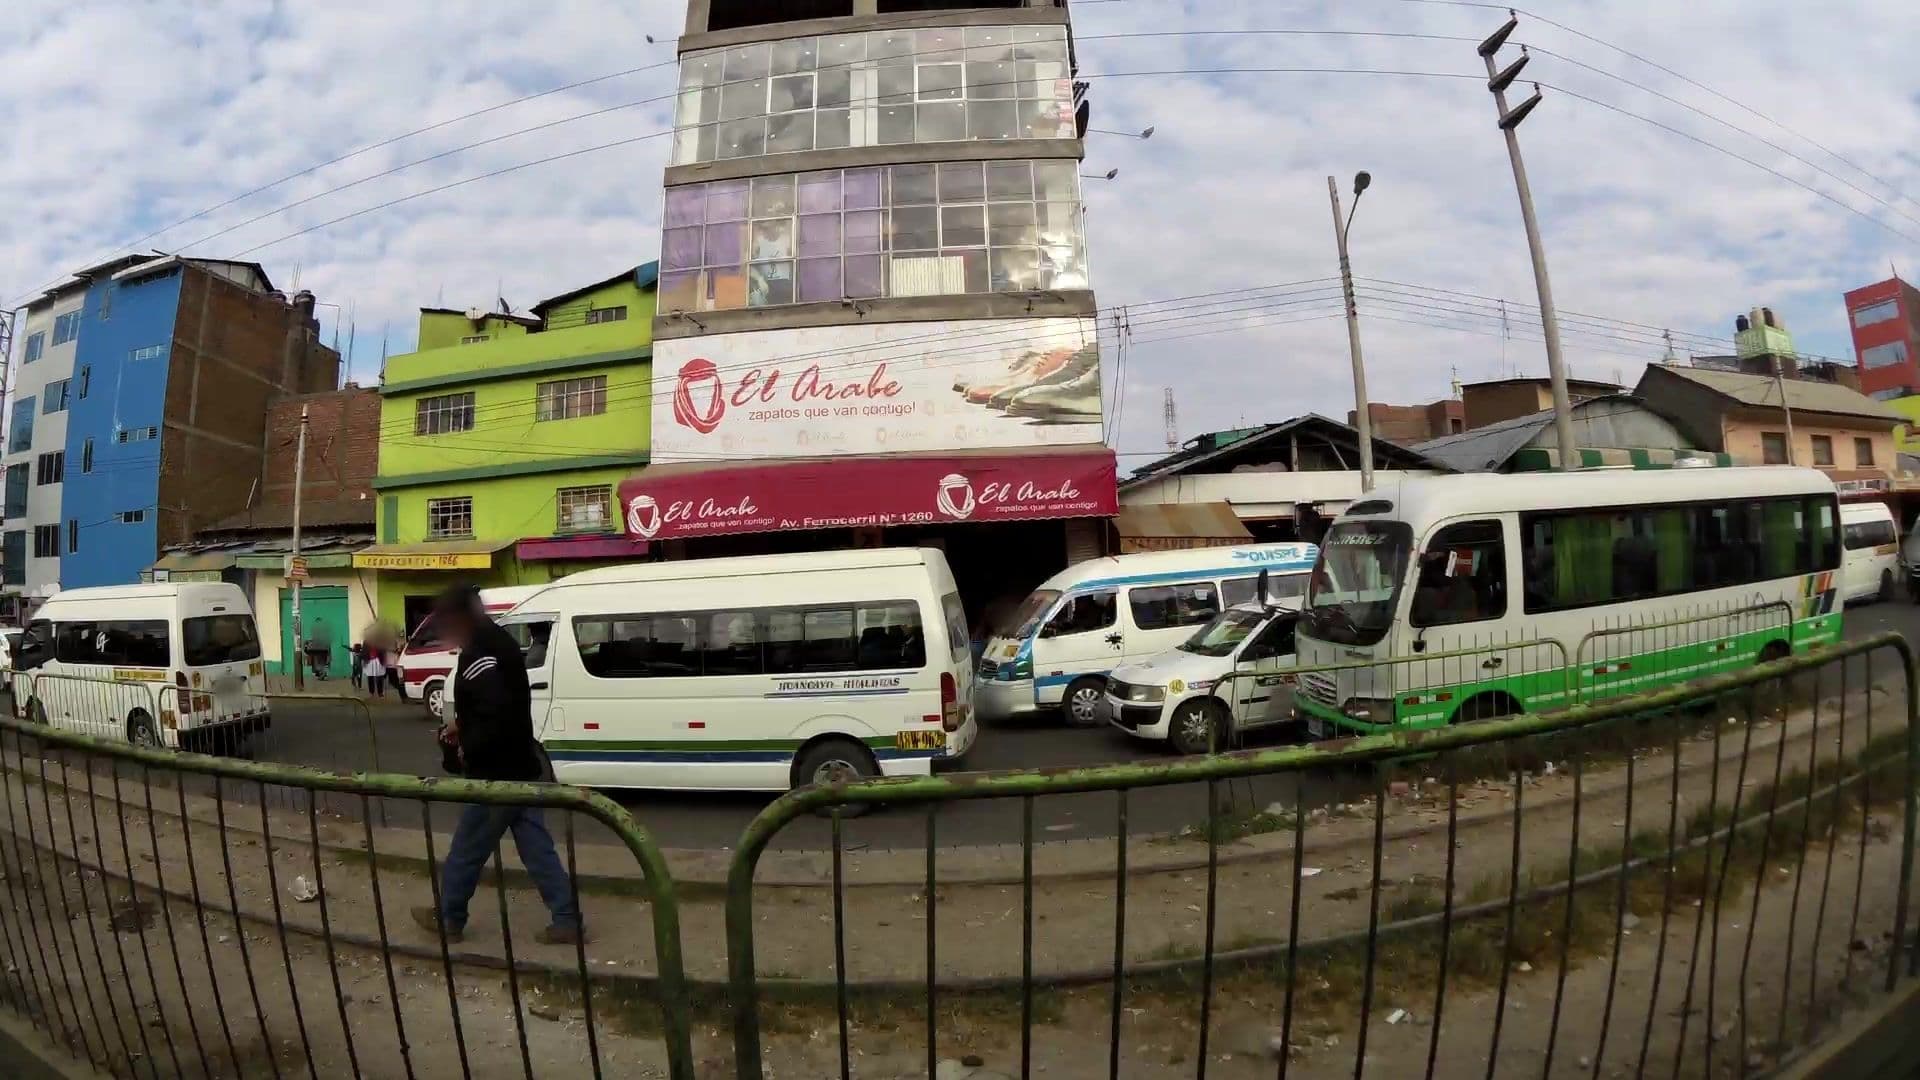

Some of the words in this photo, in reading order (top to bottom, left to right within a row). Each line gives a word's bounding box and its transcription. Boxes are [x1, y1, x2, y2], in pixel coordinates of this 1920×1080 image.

[731, 369, 780, 407] El
[792, 363, 903, 402] Arabe
[804, 406, 829, 420] que
[833, 406, 858, 416] van
[978, 482, 1012, 504] El
[1017, 479, 1080, 501] Arabe
[663, 500, 694, 523] El
[698, 496, 759, 519] Arabe
[780, 518, 800, 528] Av.
[804, 513, 876, 526] Ferrocarril
[901, 511, 934, 522] 1260
[710, 521, 726, 529] que
